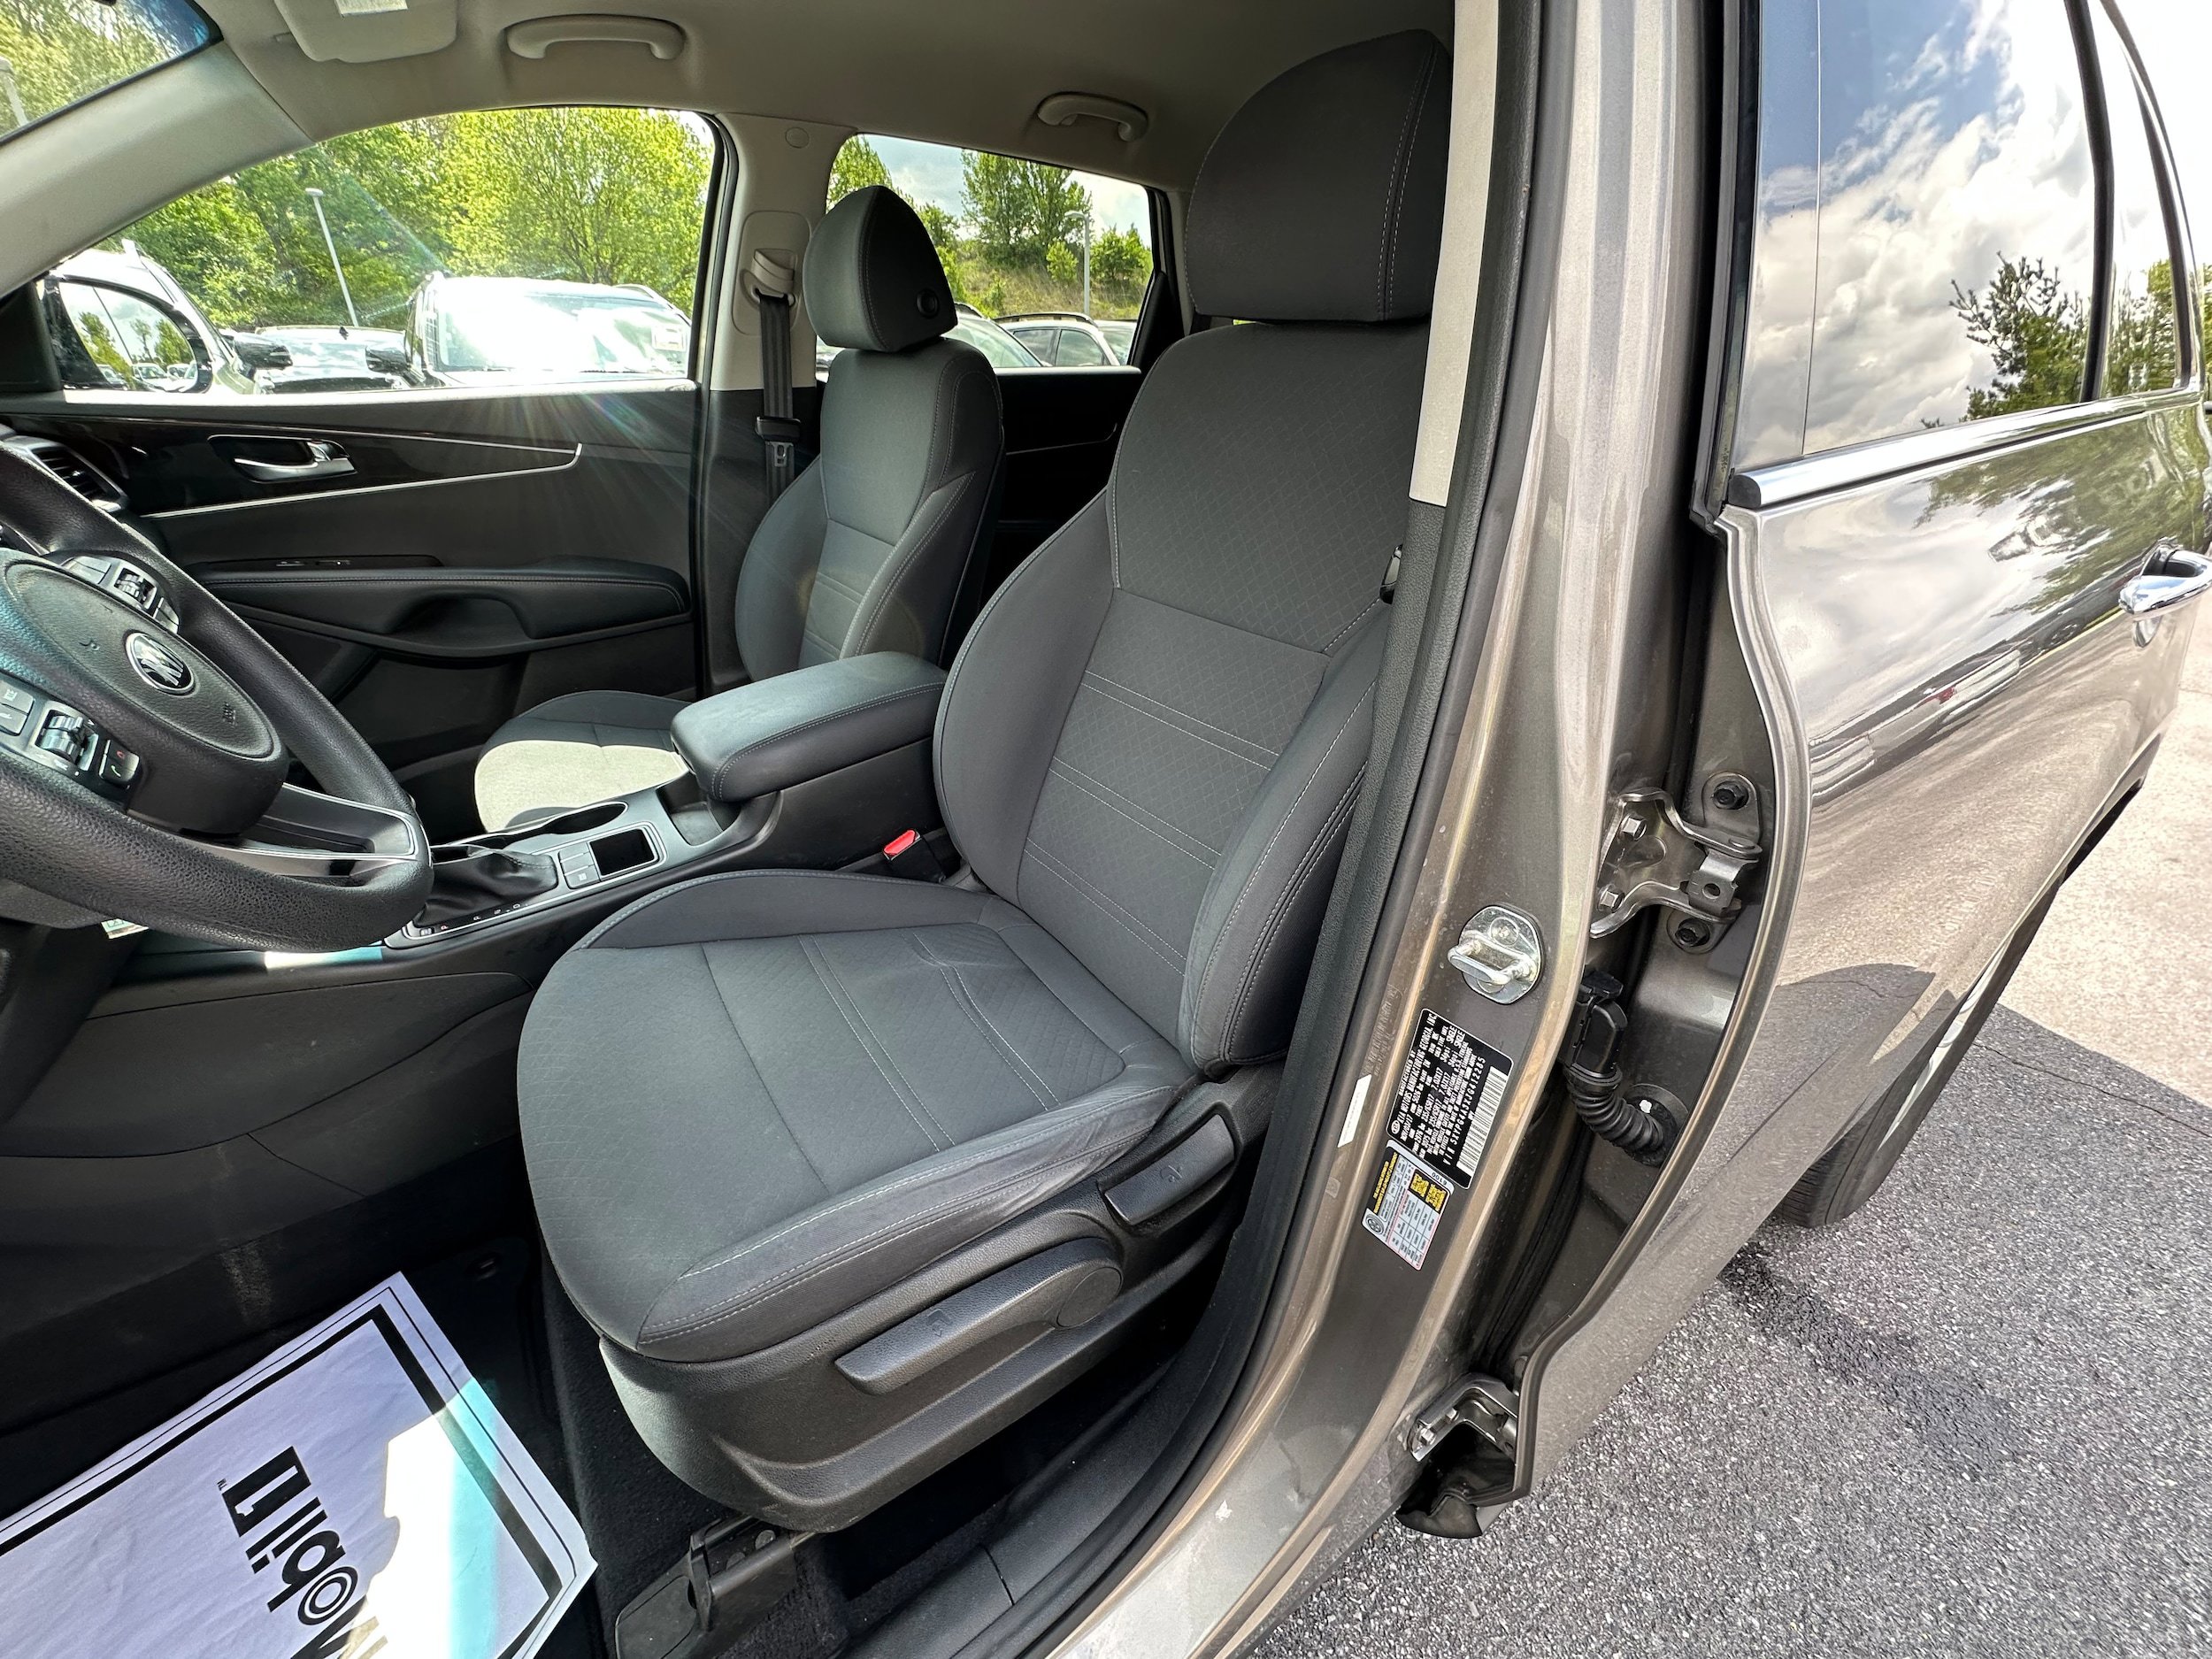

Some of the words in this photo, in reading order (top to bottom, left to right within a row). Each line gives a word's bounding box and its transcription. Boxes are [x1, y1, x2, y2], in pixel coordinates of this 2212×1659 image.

[1406, 1049, 1425, 1091] MANUFACTURING
[1400, 1090, 1412, 1112] MOTORS
[1396, 1111, 1406, 1124] KIA
